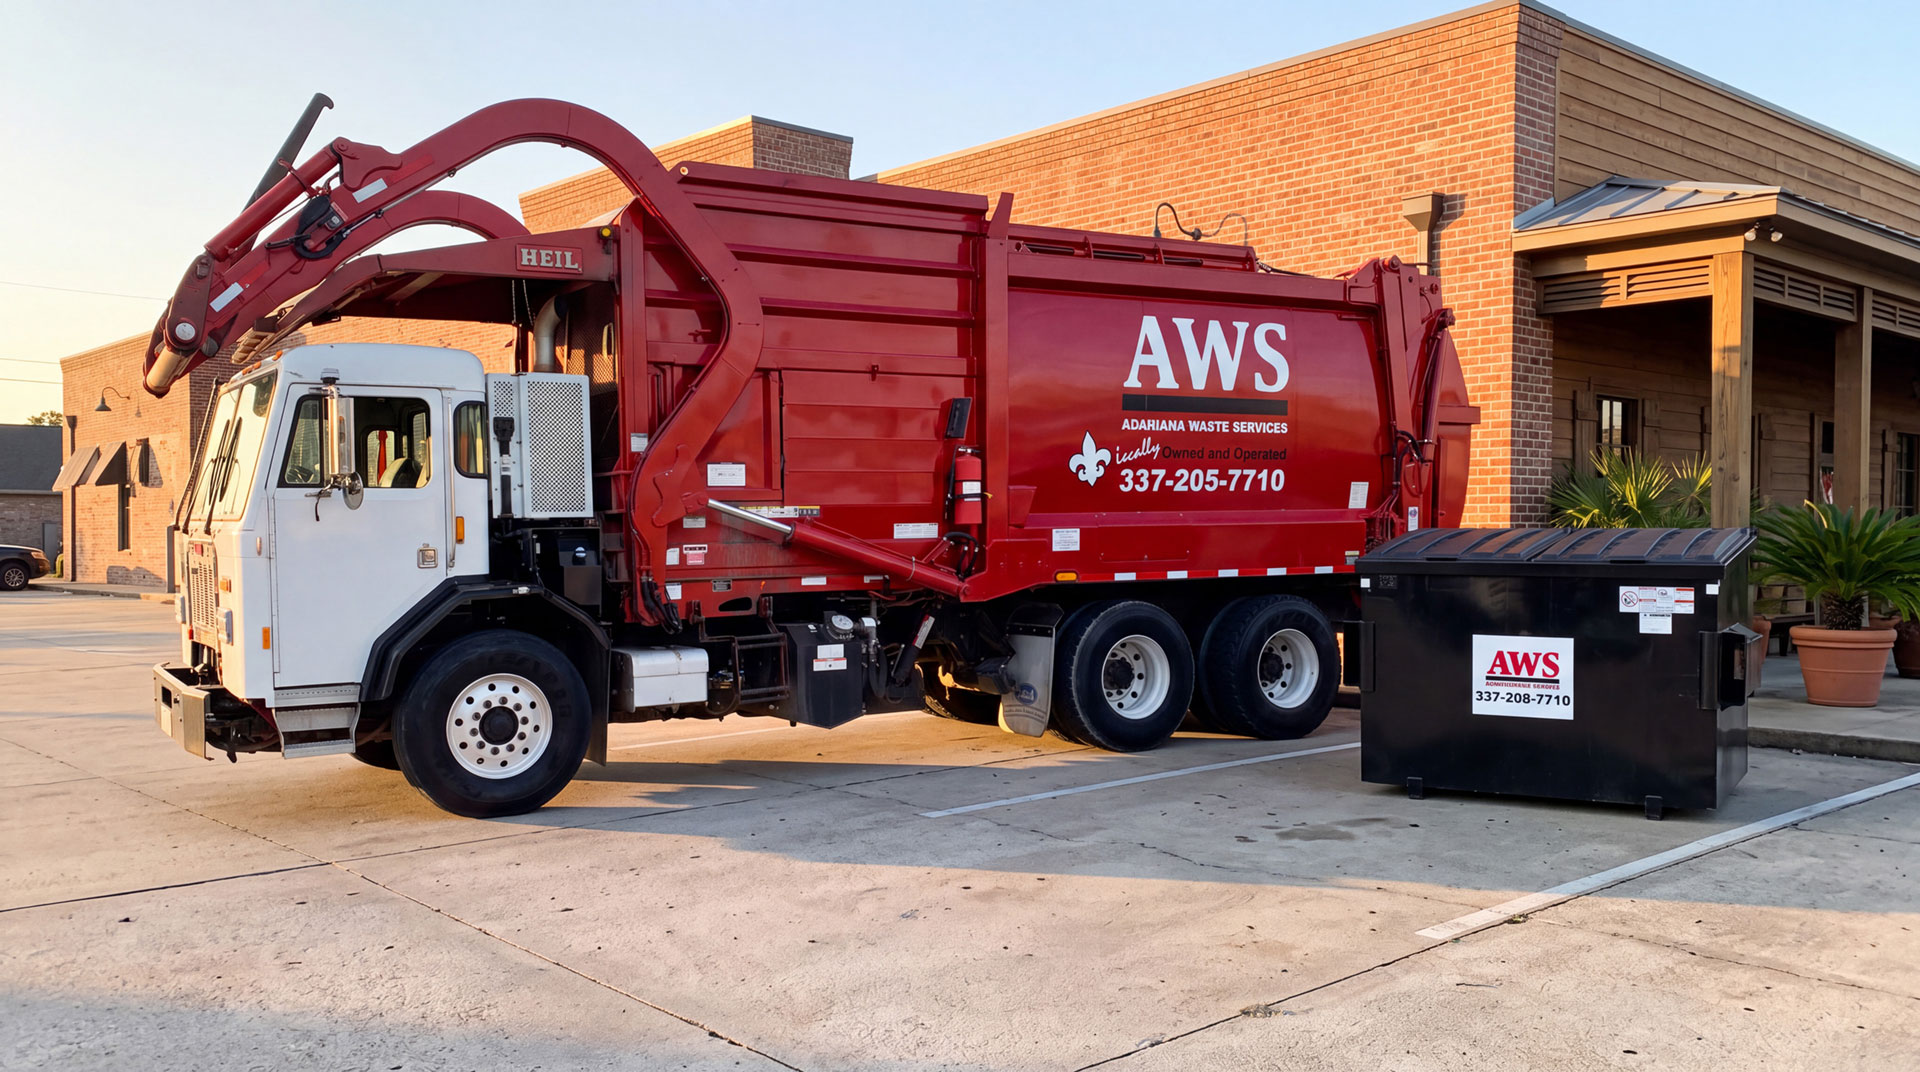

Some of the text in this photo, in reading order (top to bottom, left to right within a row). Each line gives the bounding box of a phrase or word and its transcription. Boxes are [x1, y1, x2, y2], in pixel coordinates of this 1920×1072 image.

[520, 248, 579, 269] HEIL
[1123, 315, 1290, 393] AWS
[1188, 420, 1230, 432] WASTE
[1233, 421, 1288, 434] SERVICES
[1162, 446, 1204, 459] Owned
[1208, 447, 1230, 459] and
[1234, 447, 1287, 462] Operated
[1119, 468, 1285, 492] 337-205-7710
[1486, 650, 1560, 678] AWS
[1475, 691, 1571, 706] 337-208-7710
